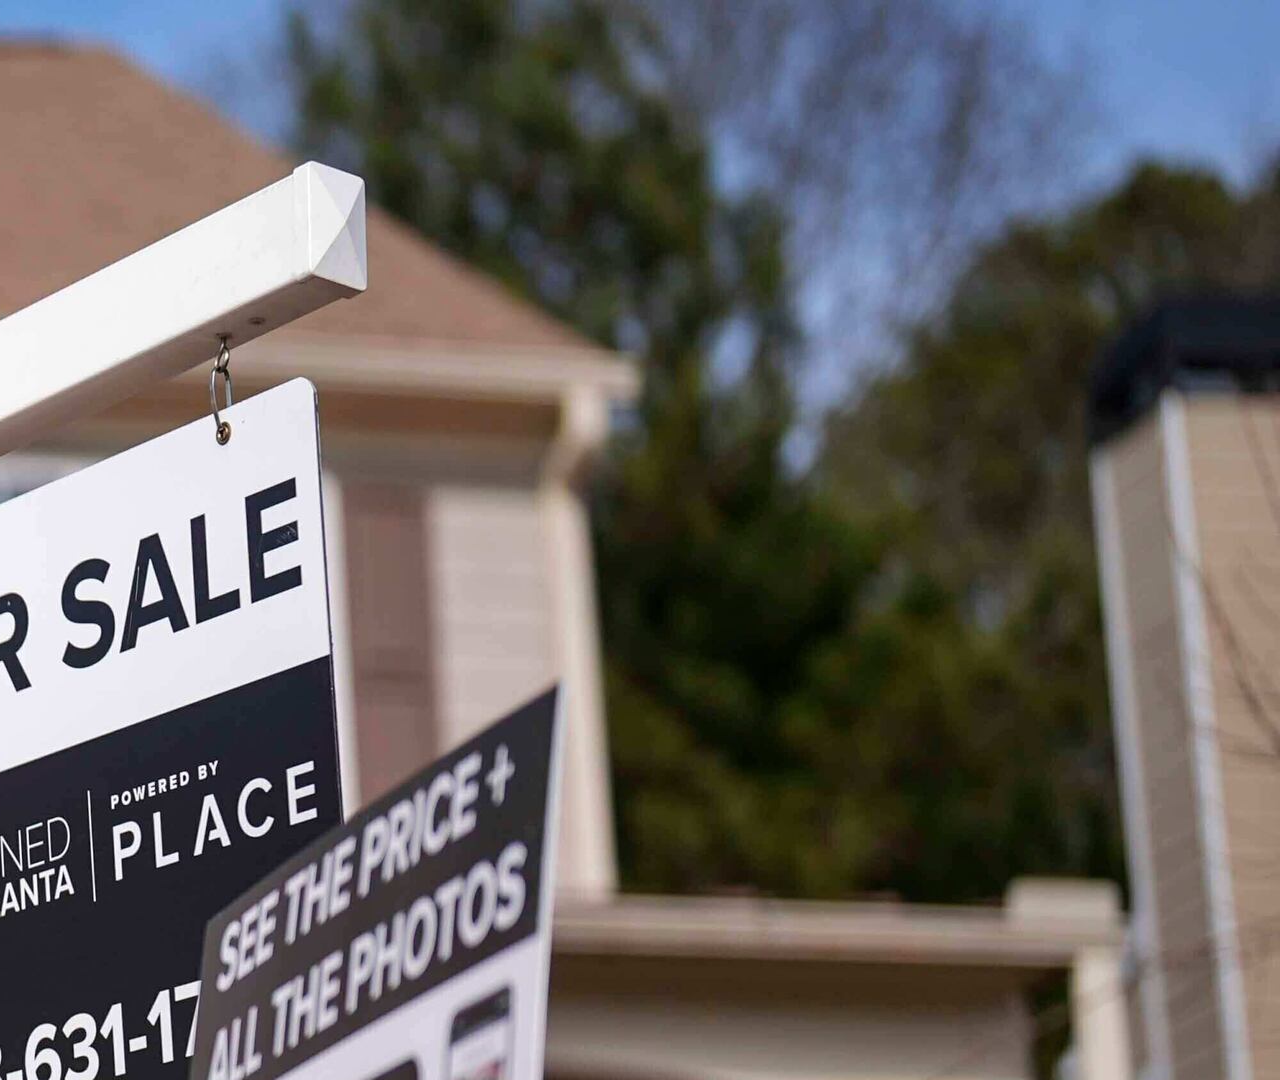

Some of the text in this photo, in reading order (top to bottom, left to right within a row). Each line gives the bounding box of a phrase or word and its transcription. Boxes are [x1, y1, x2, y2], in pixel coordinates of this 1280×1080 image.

[62, 477, 302, 668] SALE
[111, 760, 219, 810] POWERED BY
[112, 760, 318, 881] PLACE
[216, 889, 279, 992] SEE
[284, 836, 357, 946] THE
[356, 750, 483, 899] PRICE
[271, 951, 343, 1058] THE
[345, 841, 528, 1015] PHOTOS
